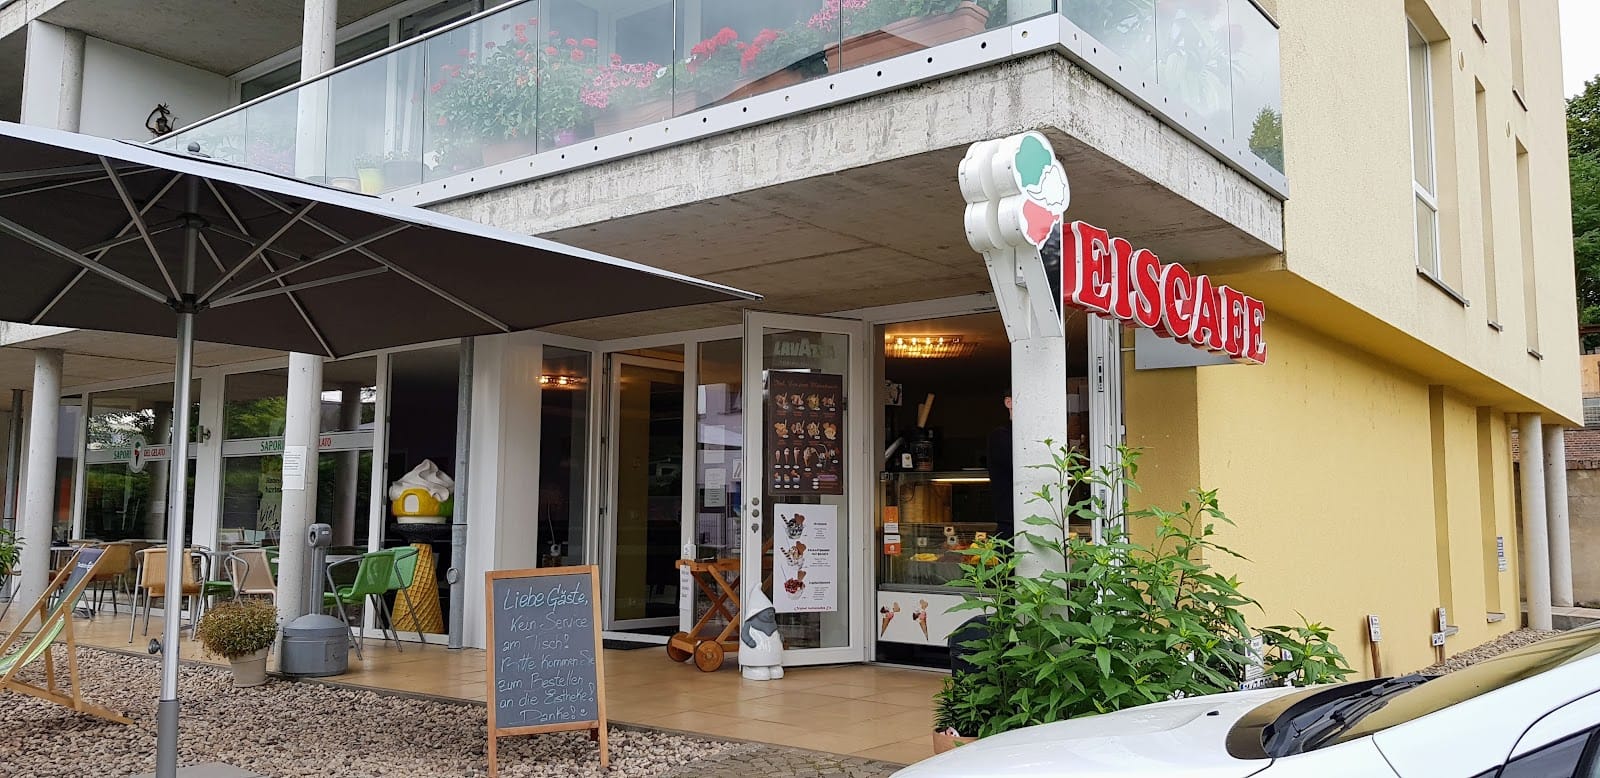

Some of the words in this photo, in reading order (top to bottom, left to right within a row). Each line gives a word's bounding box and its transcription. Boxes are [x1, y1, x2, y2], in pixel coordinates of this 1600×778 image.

[1070, 220, 1267, 364] EISCAFE
[773, 338, 838, 359] LAVA
[503, 586, 545, 610] Liebe
[546, 582, 589, 612] Gäste,
[510, 615, 537, 632] Kein
[540, 611, 589, 630] Service
[502, 640, 521, 652] am
[525, 633, 570, 650] Tisch!
[497, 679, 522, 693] zum
[499, 698, 514, 709] an
[518, 692, 539, 707] die
